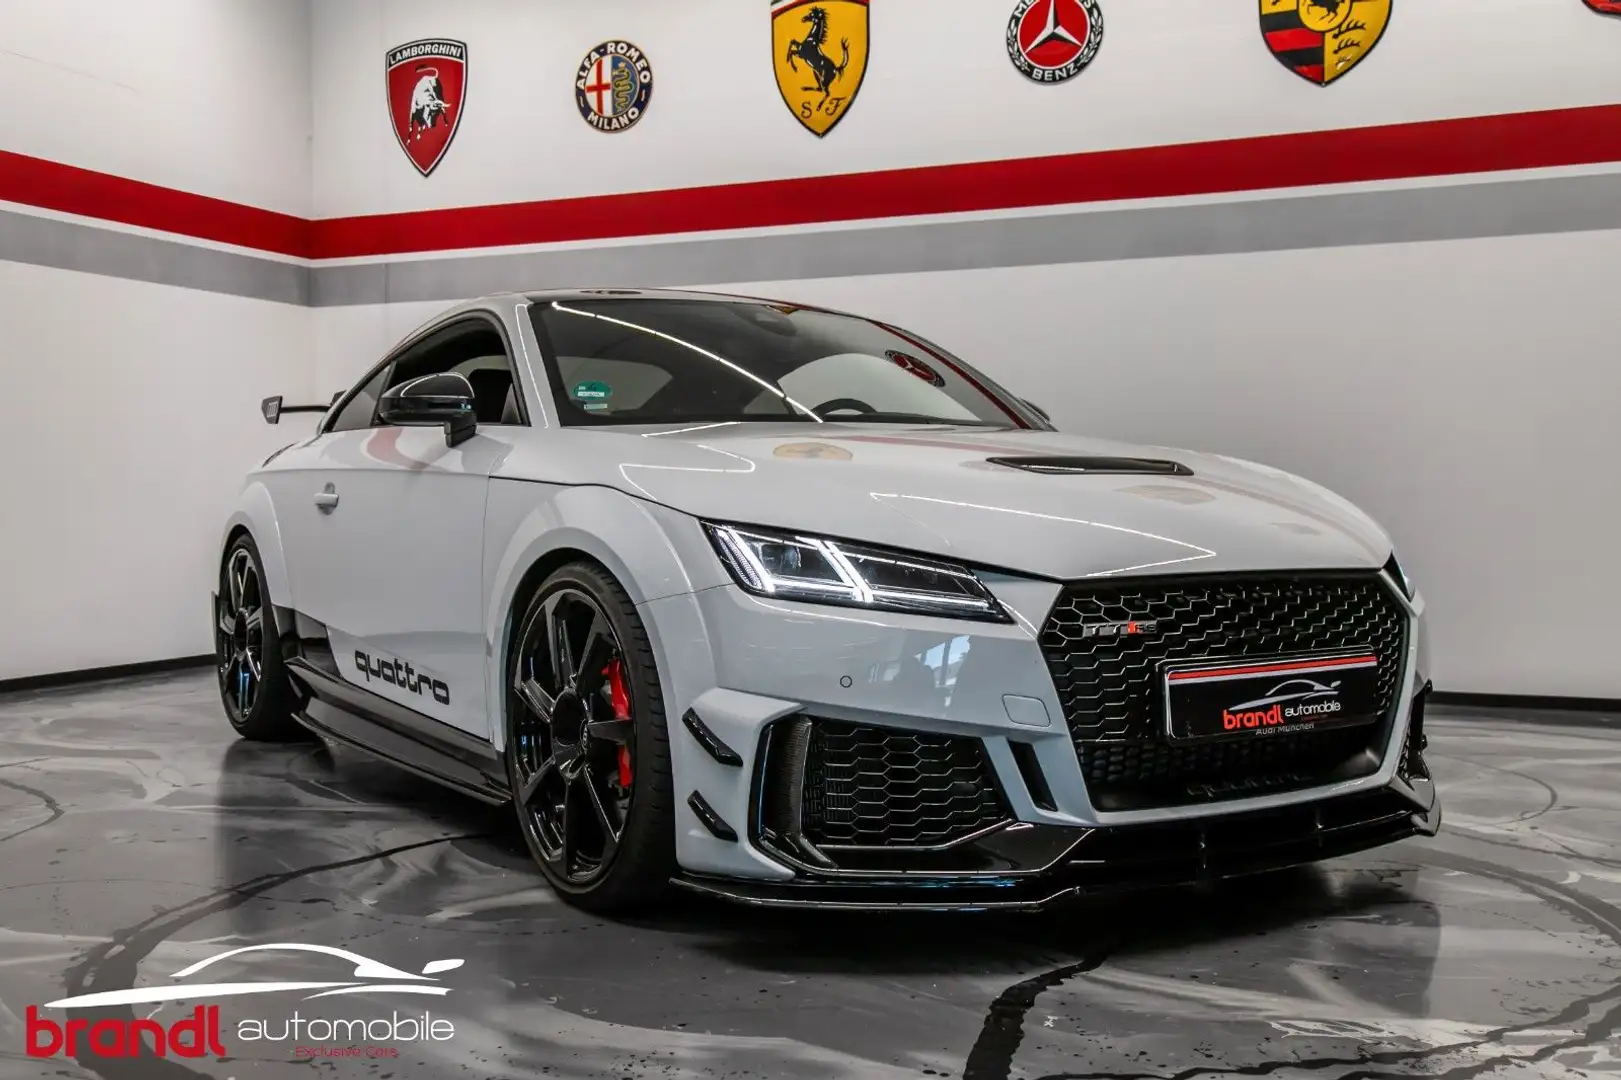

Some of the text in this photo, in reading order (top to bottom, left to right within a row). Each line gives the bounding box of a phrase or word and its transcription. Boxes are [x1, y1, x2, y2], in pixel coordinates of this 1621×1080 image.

[389, 43, 462, 64] LAMBORGHINI
[1031, 62, 1078, 81] BENZ
[587, 107, 639, 130] MILANO
[354, 649, 450, 706] quattro
[1222, 700, 1341, 730] brandl automobile
[1255, 727, 1276, 736] Audi
